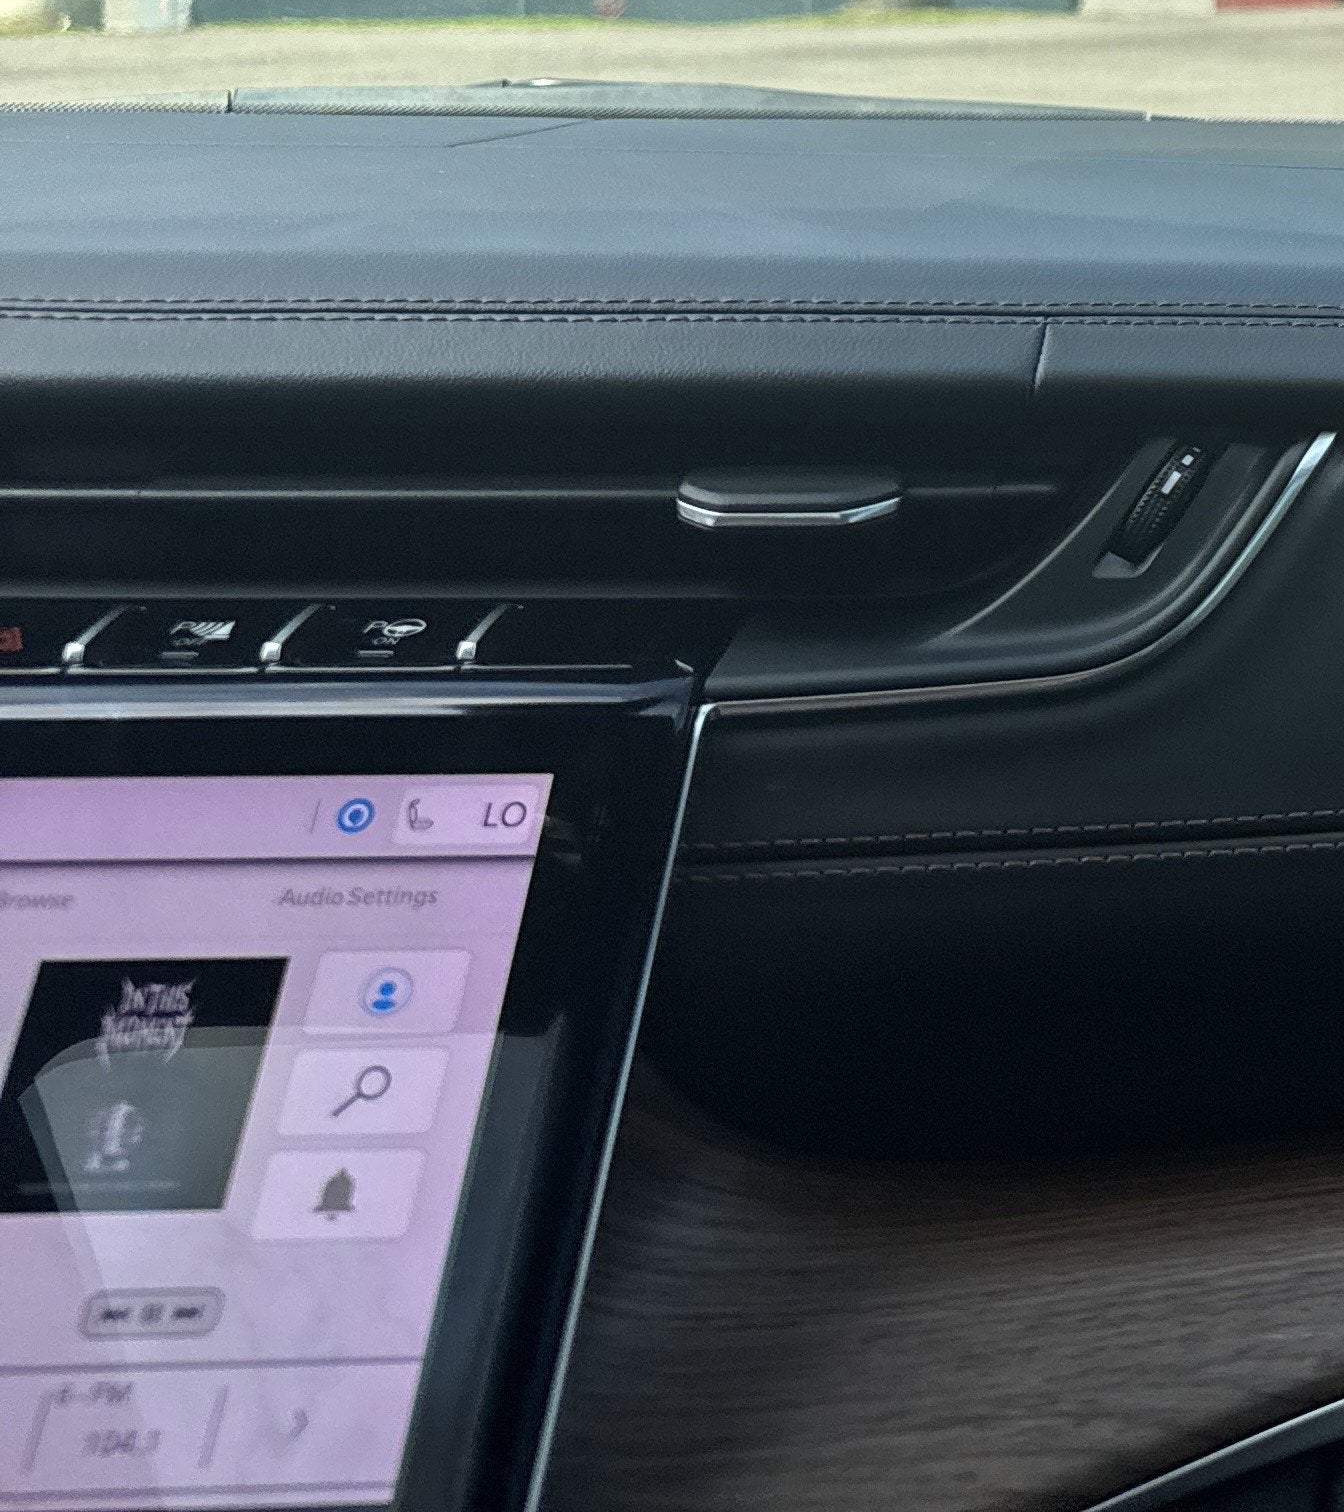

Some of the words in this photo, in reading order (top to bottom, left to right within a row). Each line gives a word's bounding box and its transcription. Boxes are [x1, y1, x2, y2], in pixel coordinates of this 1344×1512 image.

[482, 801, 528, 828] LO
[277, 889, 343, 907] Audio
[348, 888, 439, 910] Settings
